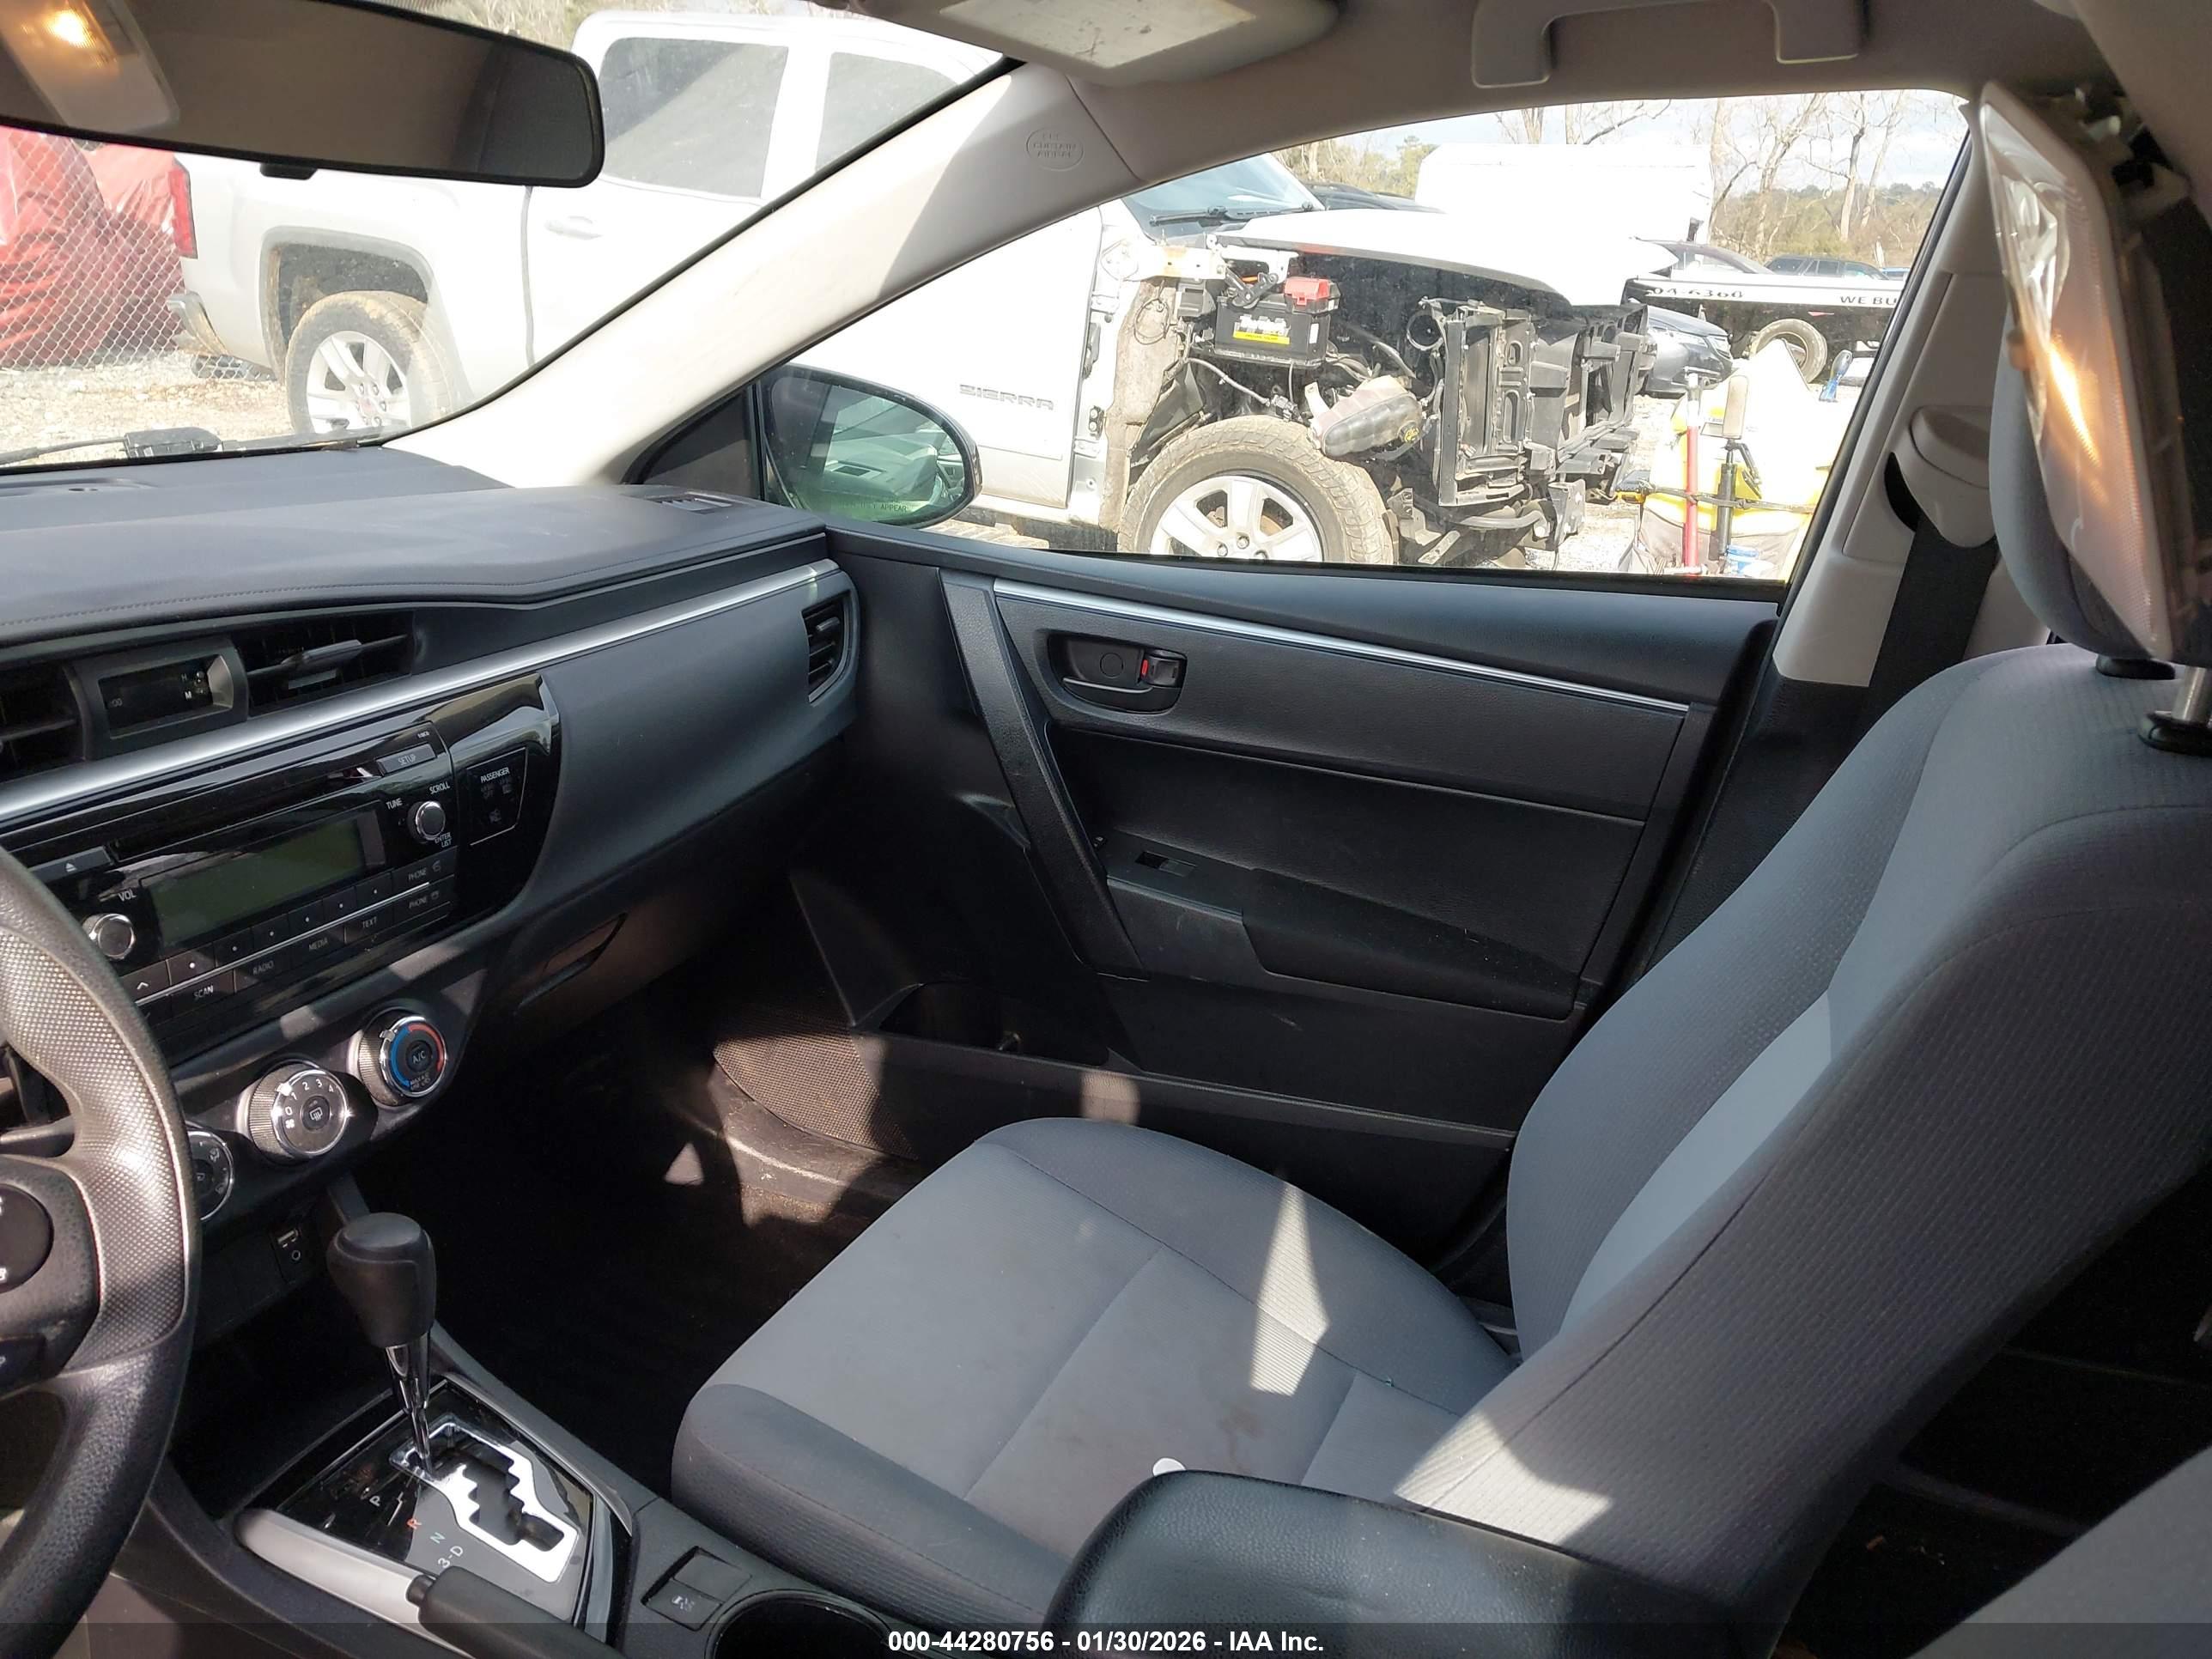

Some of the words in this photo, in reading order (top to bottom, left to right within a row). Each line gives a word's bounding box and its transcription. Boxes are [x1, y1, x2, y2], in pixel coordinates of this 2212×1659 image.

[1840, 296, 1866, 305] WE
[960, 384, 1054, 411] SIERRA
[880, 503, 907, 513] APPEAR
[185, 690, 192, 700] M
[398, 755, 416, 766] SETUP
[481, 767, 510, 783] PASSENGER
[430, 781, 451, 794] SCROLL
[386, 798, 403, 810] TUNE
[434, 832, 452, 844] ENTER
[441, 839, 452, 848] LIST
[408, 867, 427, 882] PHONE
[118, 889, 137, 902] VOL
[362, 916, 378, 929] TEXT
[308, 937, 328, 950] MEDIA
[252, 960, 274, 975] RADIO
[194, 985, 214, 1000] SCAN
[413, 1050, 426, 1064] A/C
[302, 1081, 310, 1091] 2
[315, 1079, 323, 1088] 3
[328, 1084, 334, 1093] 4
[291, 1091, 297, 1100] 1
[284, 1106, 293, 1115] 0
[369, 1495, 381, 1507] P
[407, 1517, 422, 1530] R
[430, 1532, 446, 1544] N
